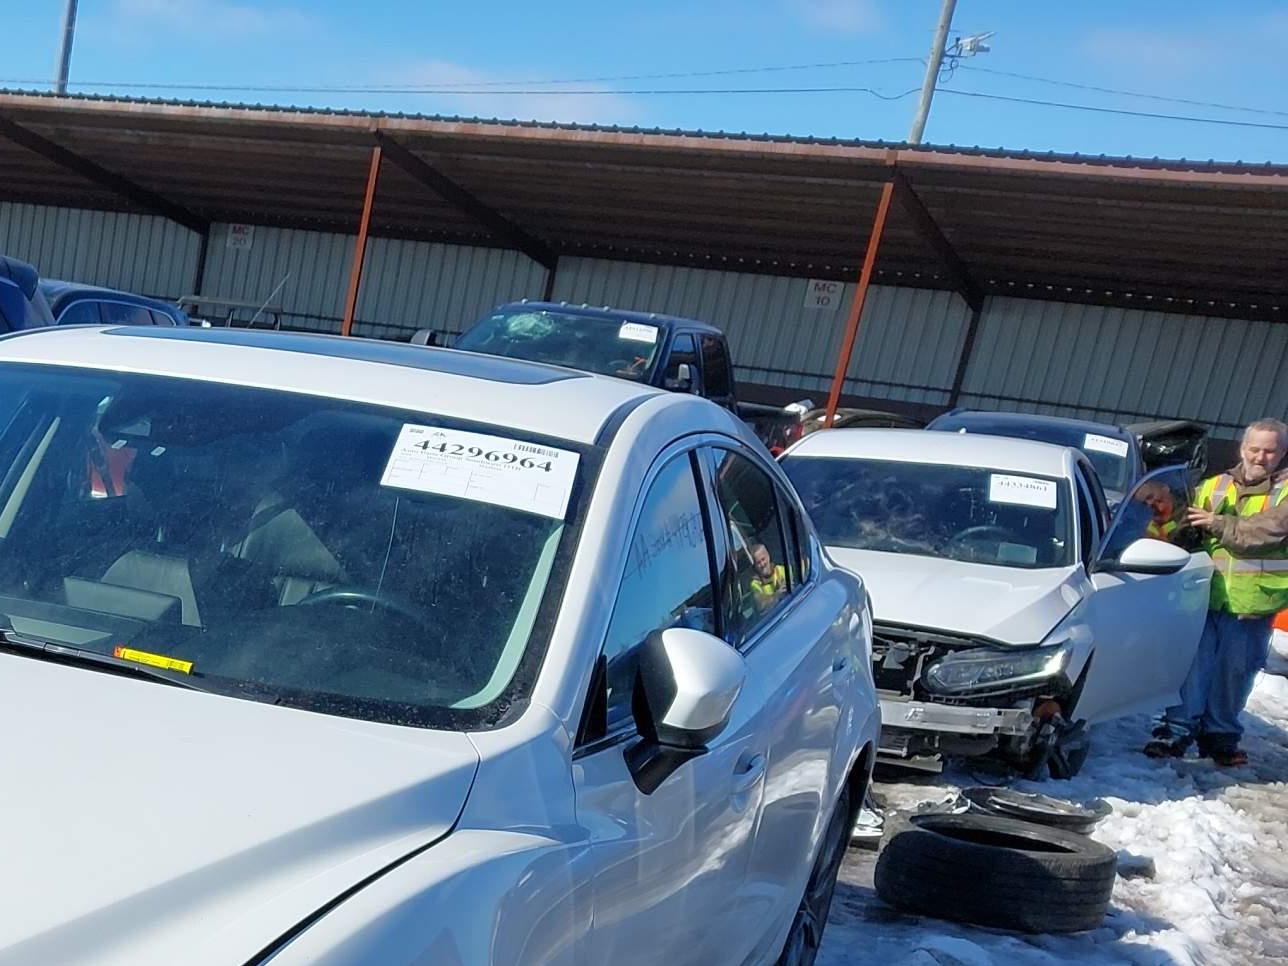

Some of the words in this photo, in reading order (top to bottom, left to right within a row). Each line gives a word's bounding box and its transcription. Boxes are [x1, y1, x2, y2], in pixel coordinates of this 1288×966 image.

[814, 282, 838, 294] MC
[816, 296, 831, 306] 10
[413, 439, 553, 473] 44296964
